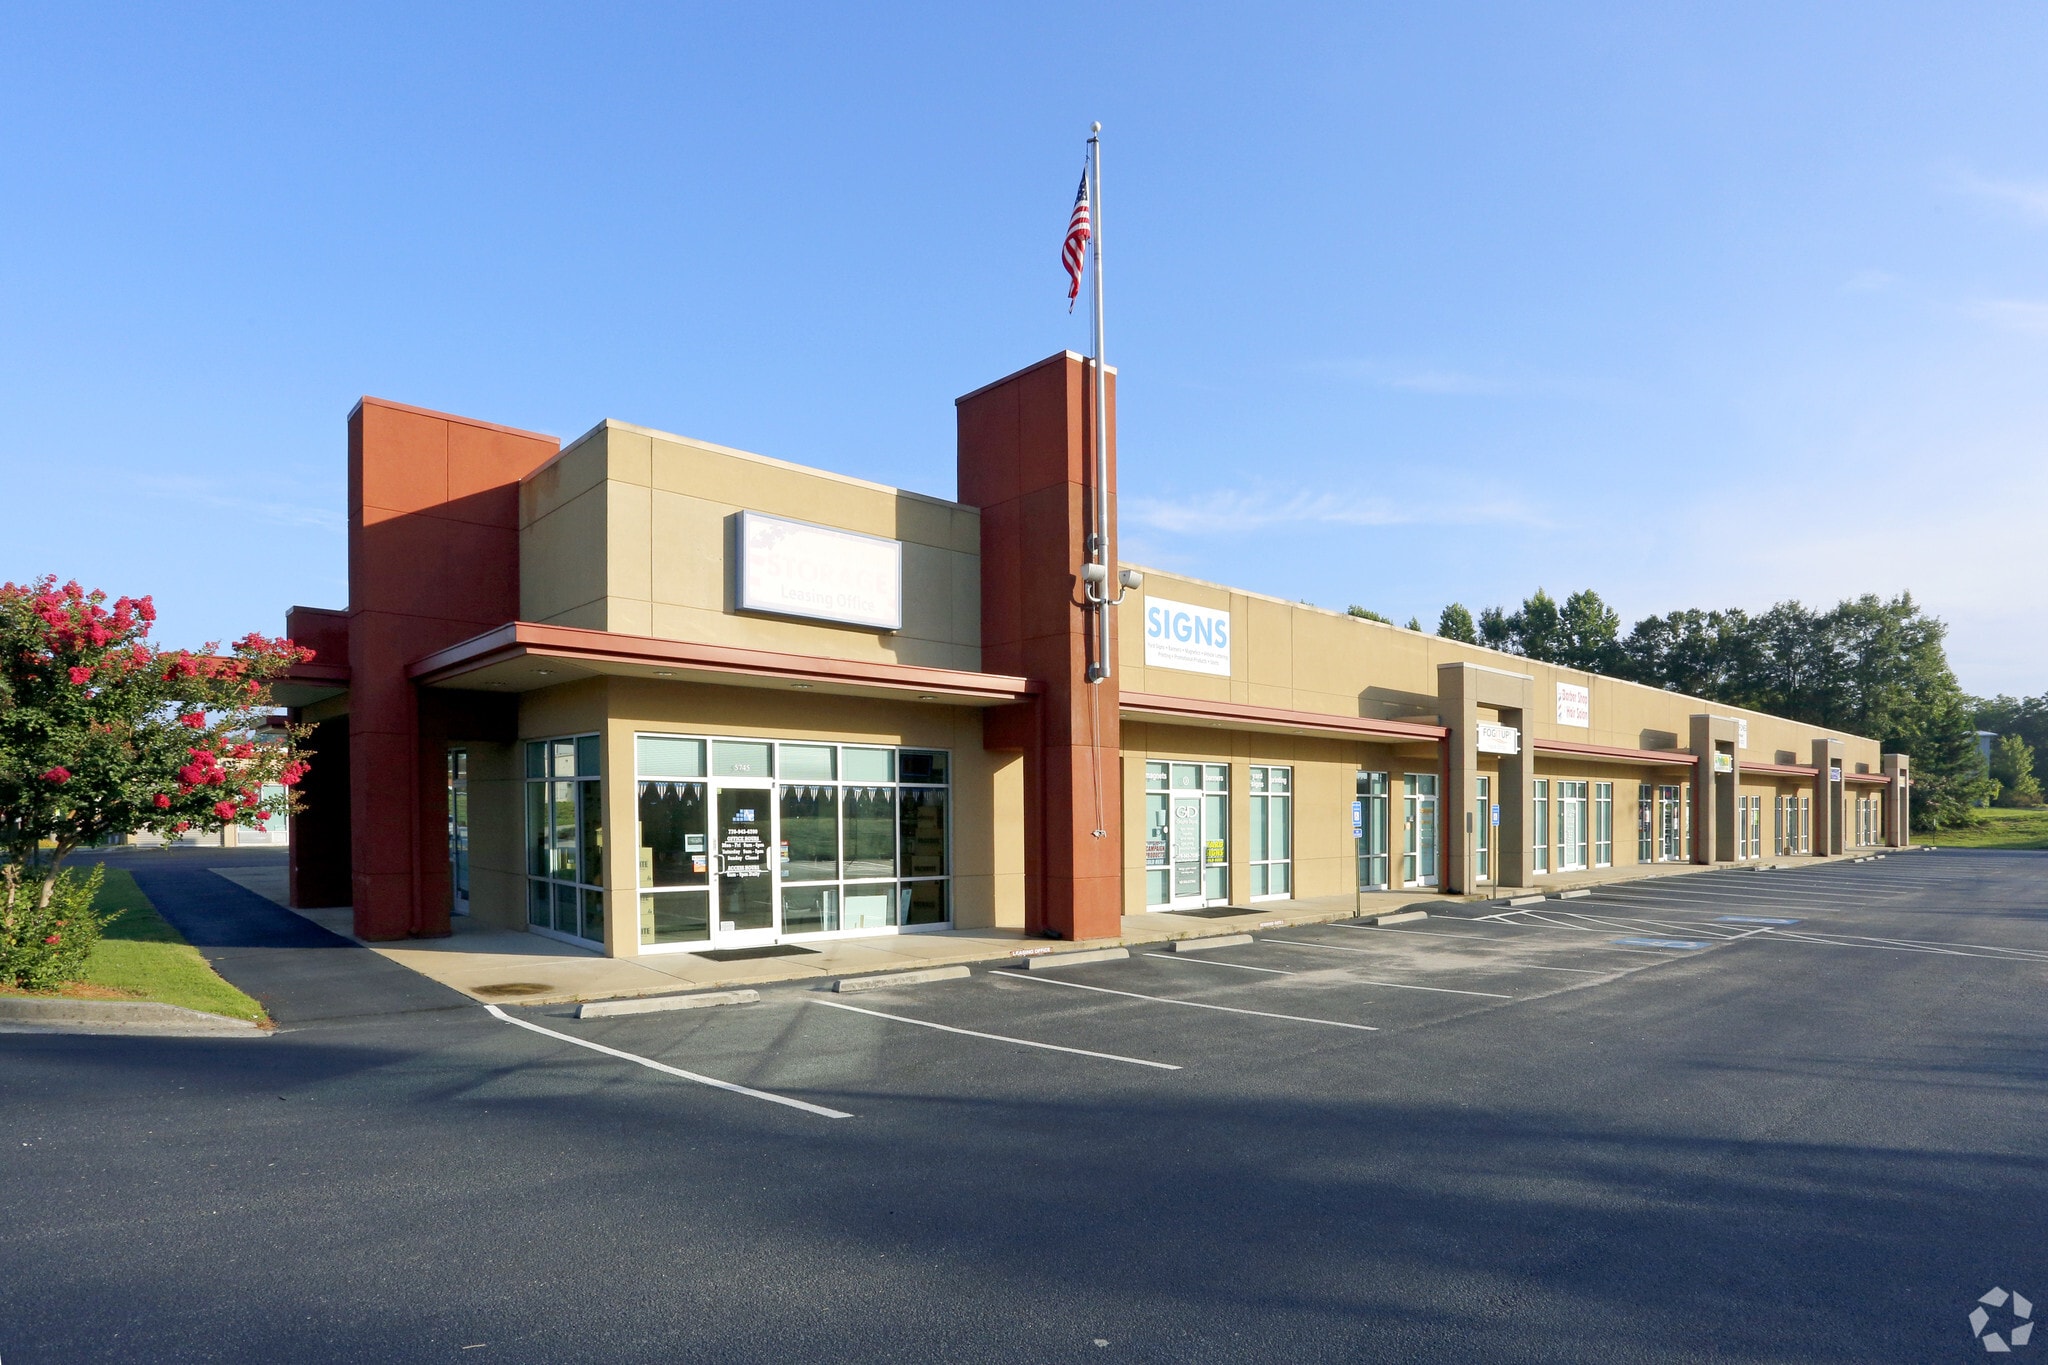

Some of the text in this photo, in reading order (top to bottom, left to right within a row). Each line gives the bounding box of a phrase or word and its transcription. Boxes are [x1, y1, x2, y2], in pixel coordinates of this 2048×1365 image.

[780, 584, 876, 612] Leasing Office
[1148, 607, 1227, 648] SIGNS
[1562, 688, 1588, 706] Barber Shop
[1483, 728, 1496, 738] FOG
